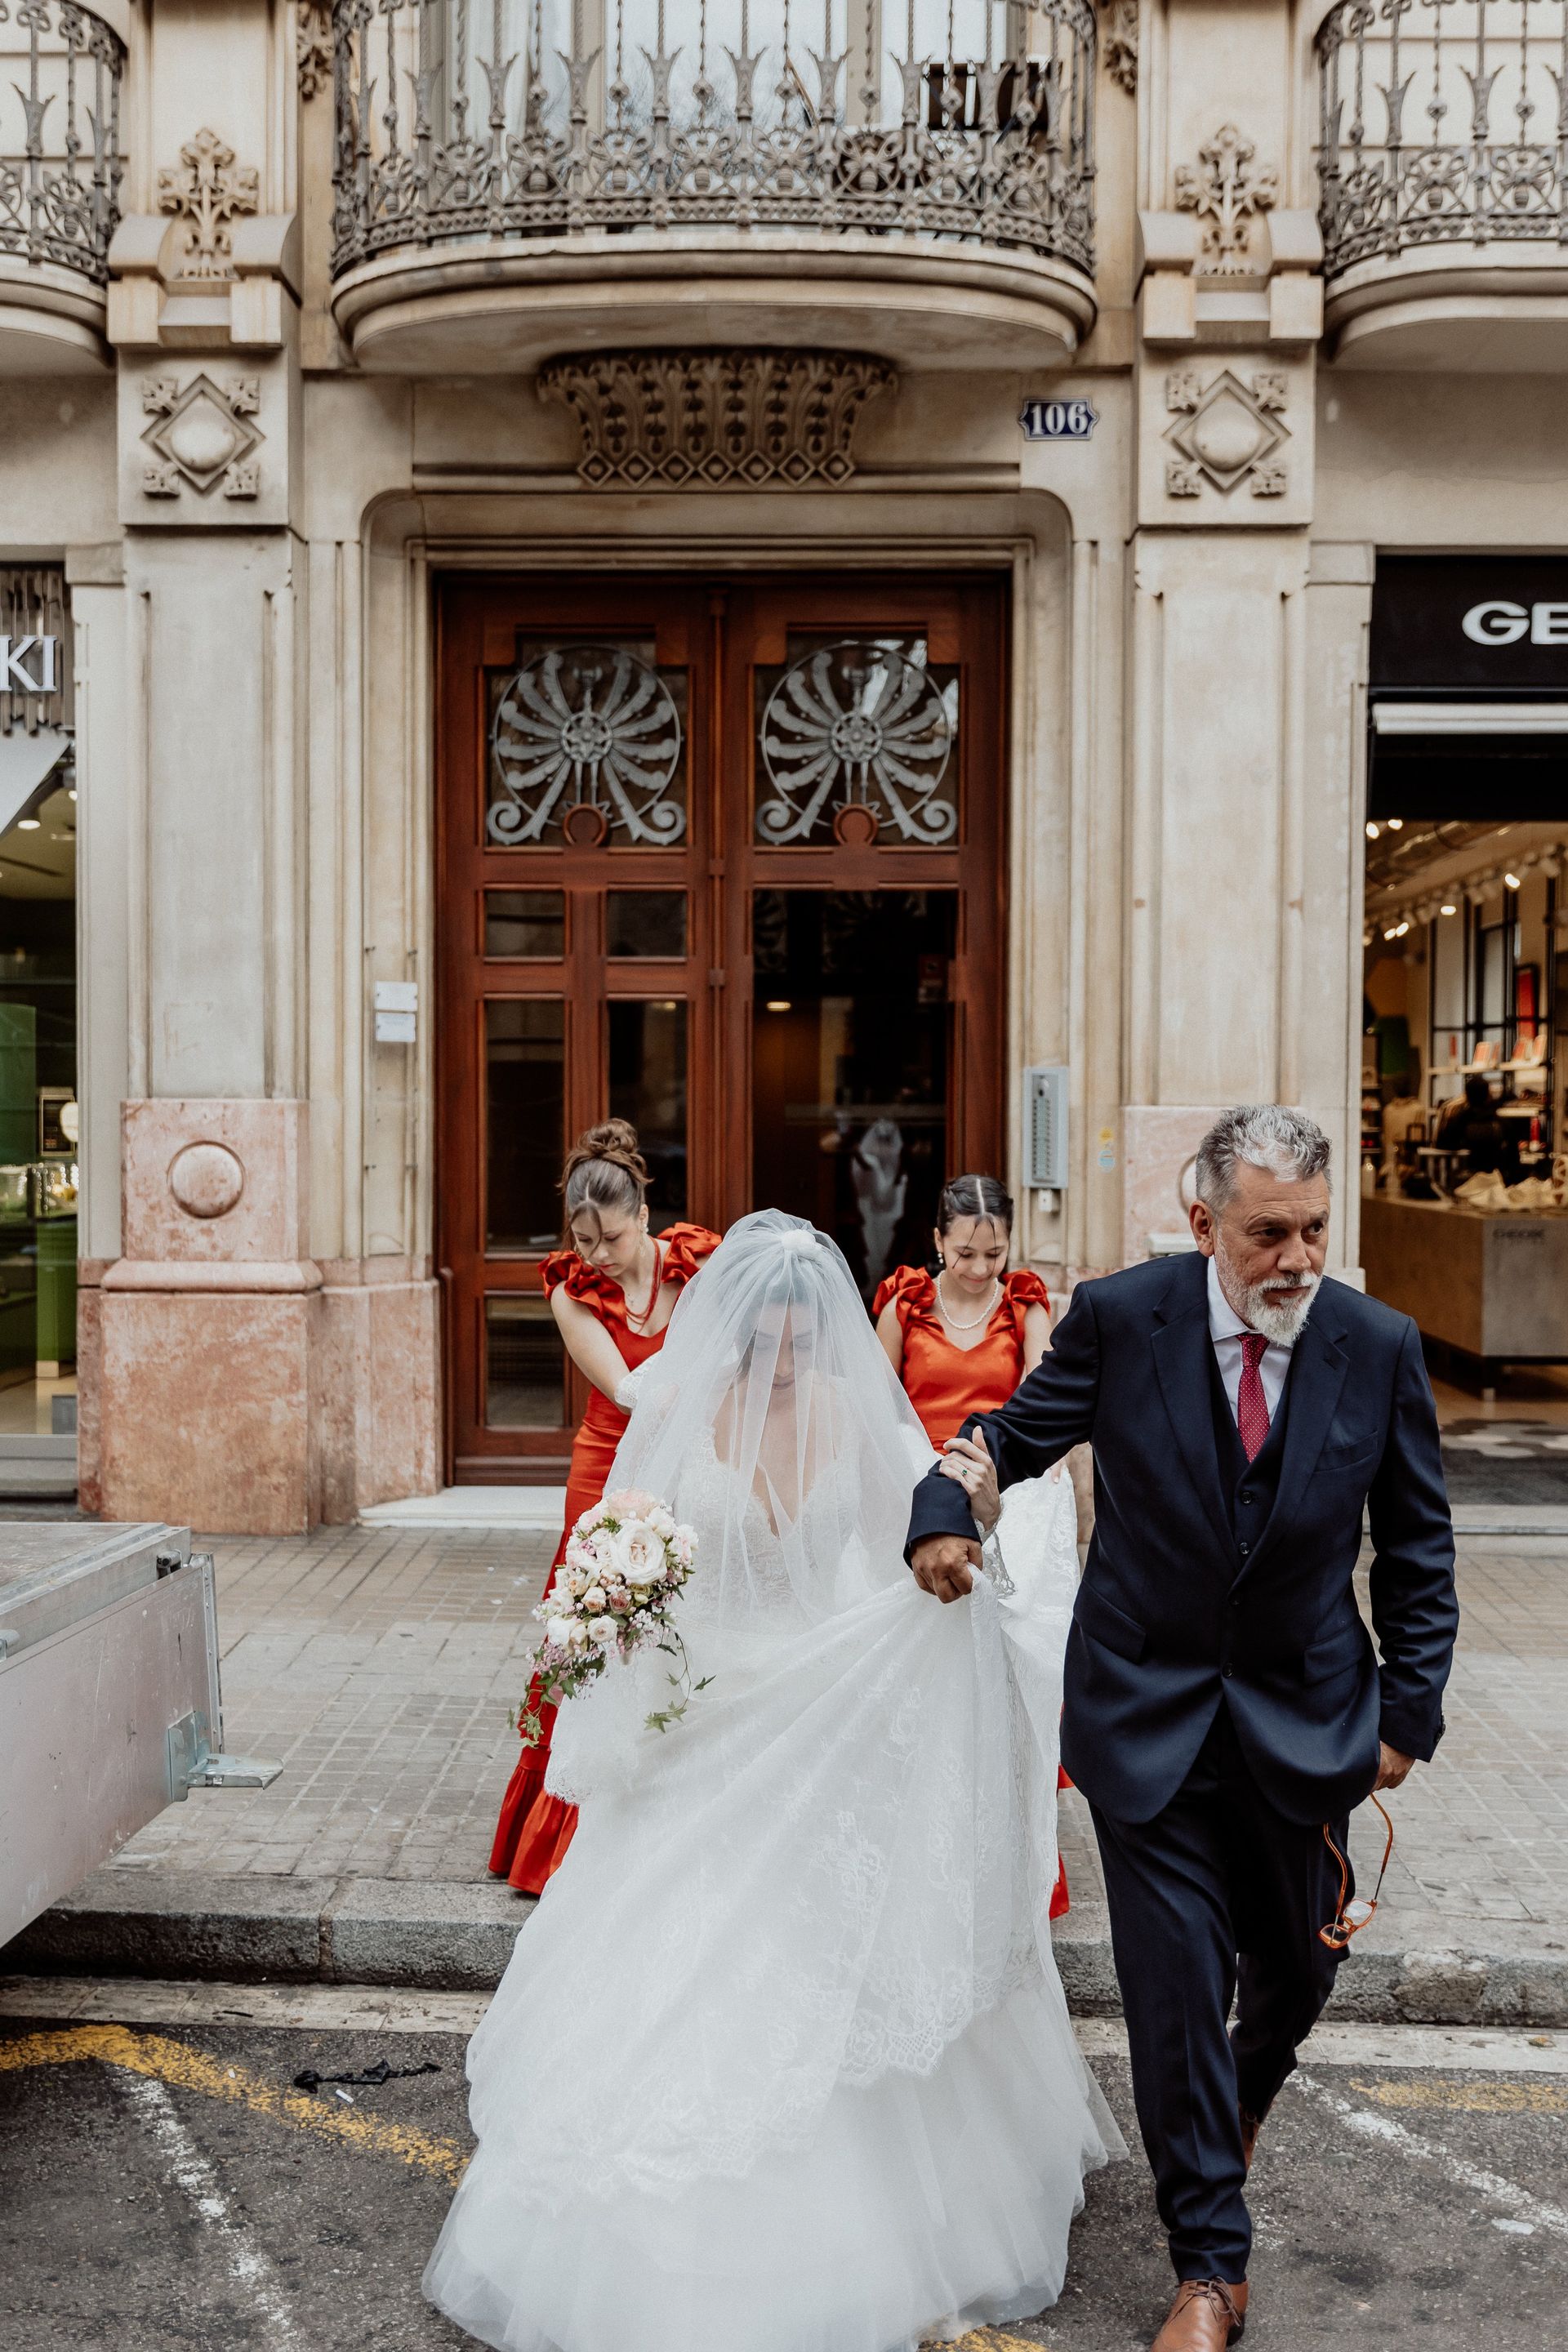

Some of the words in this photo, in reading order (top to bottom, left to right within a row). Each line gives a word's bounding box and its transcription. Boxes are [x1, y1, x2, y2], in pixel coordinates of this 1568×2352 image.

[1031, 403, 1088, 435] 106
[1461, 600, 1568, 646] GE
[0, 634, 58, 692] KI
